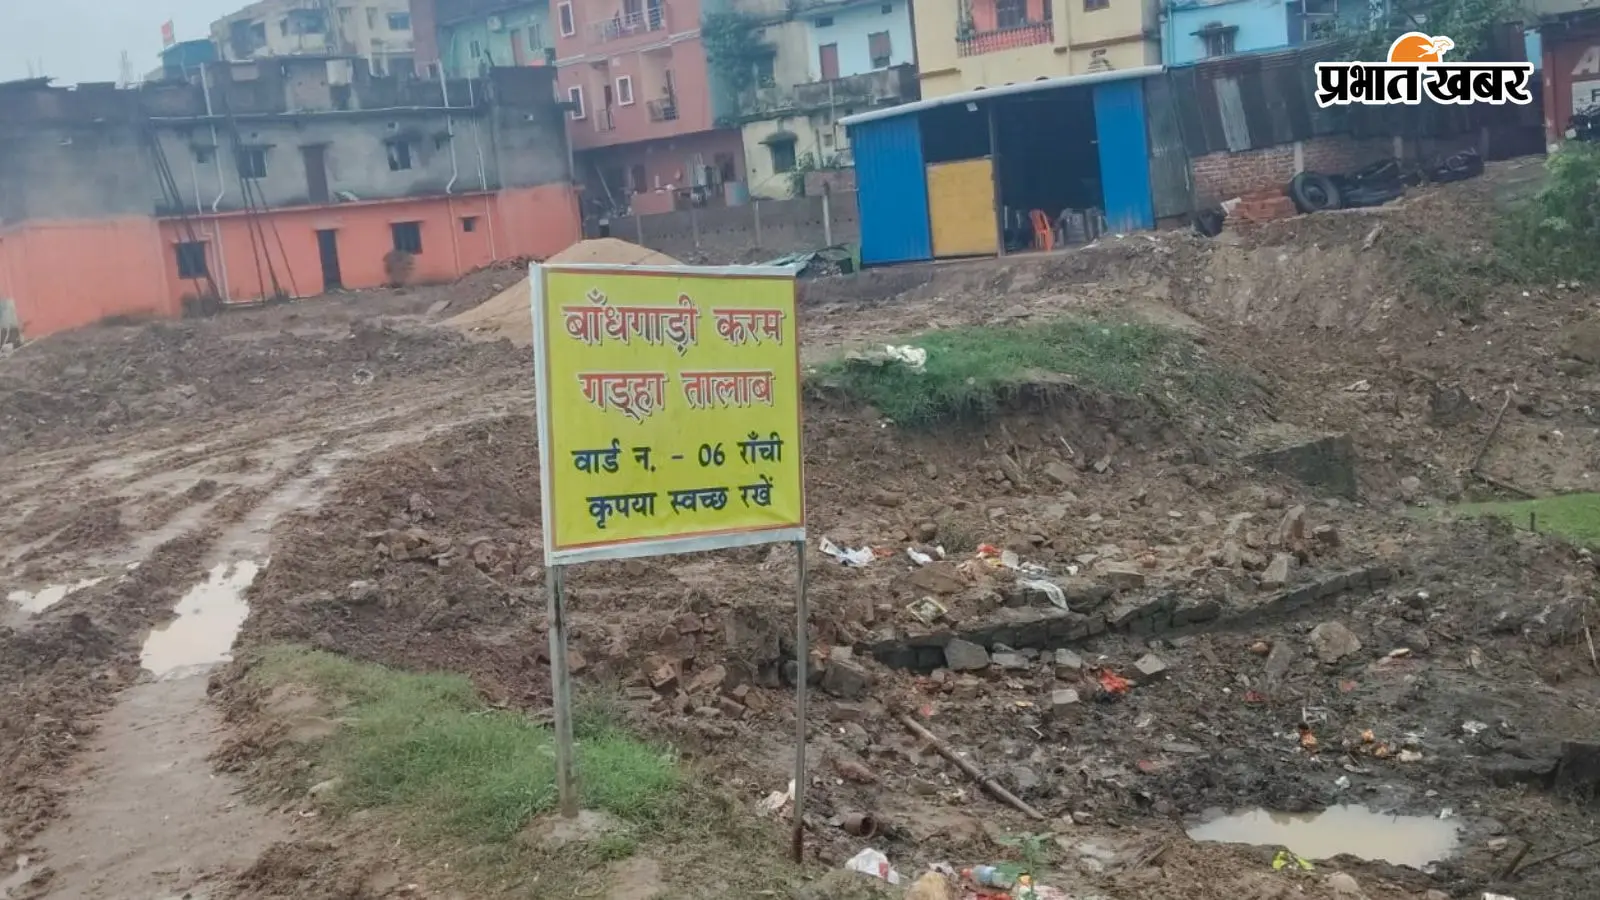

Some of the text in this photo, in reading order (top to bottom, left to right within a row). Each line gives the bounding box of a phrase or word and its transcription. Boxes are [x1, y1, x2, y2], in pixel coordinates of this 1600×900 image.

[562, 288, 786, 356] बाँधगाड़ी करम
[680, 371, 776, 409] तालाब
[571, 438, 621, 474] वार्ड
[632, 447, 656, 472] न.
[698, 442, 725, 467] 06
[736, 431, 784, 464] राँची
[586, 473, 774, 529] कृपया स्वच्छ रखें
